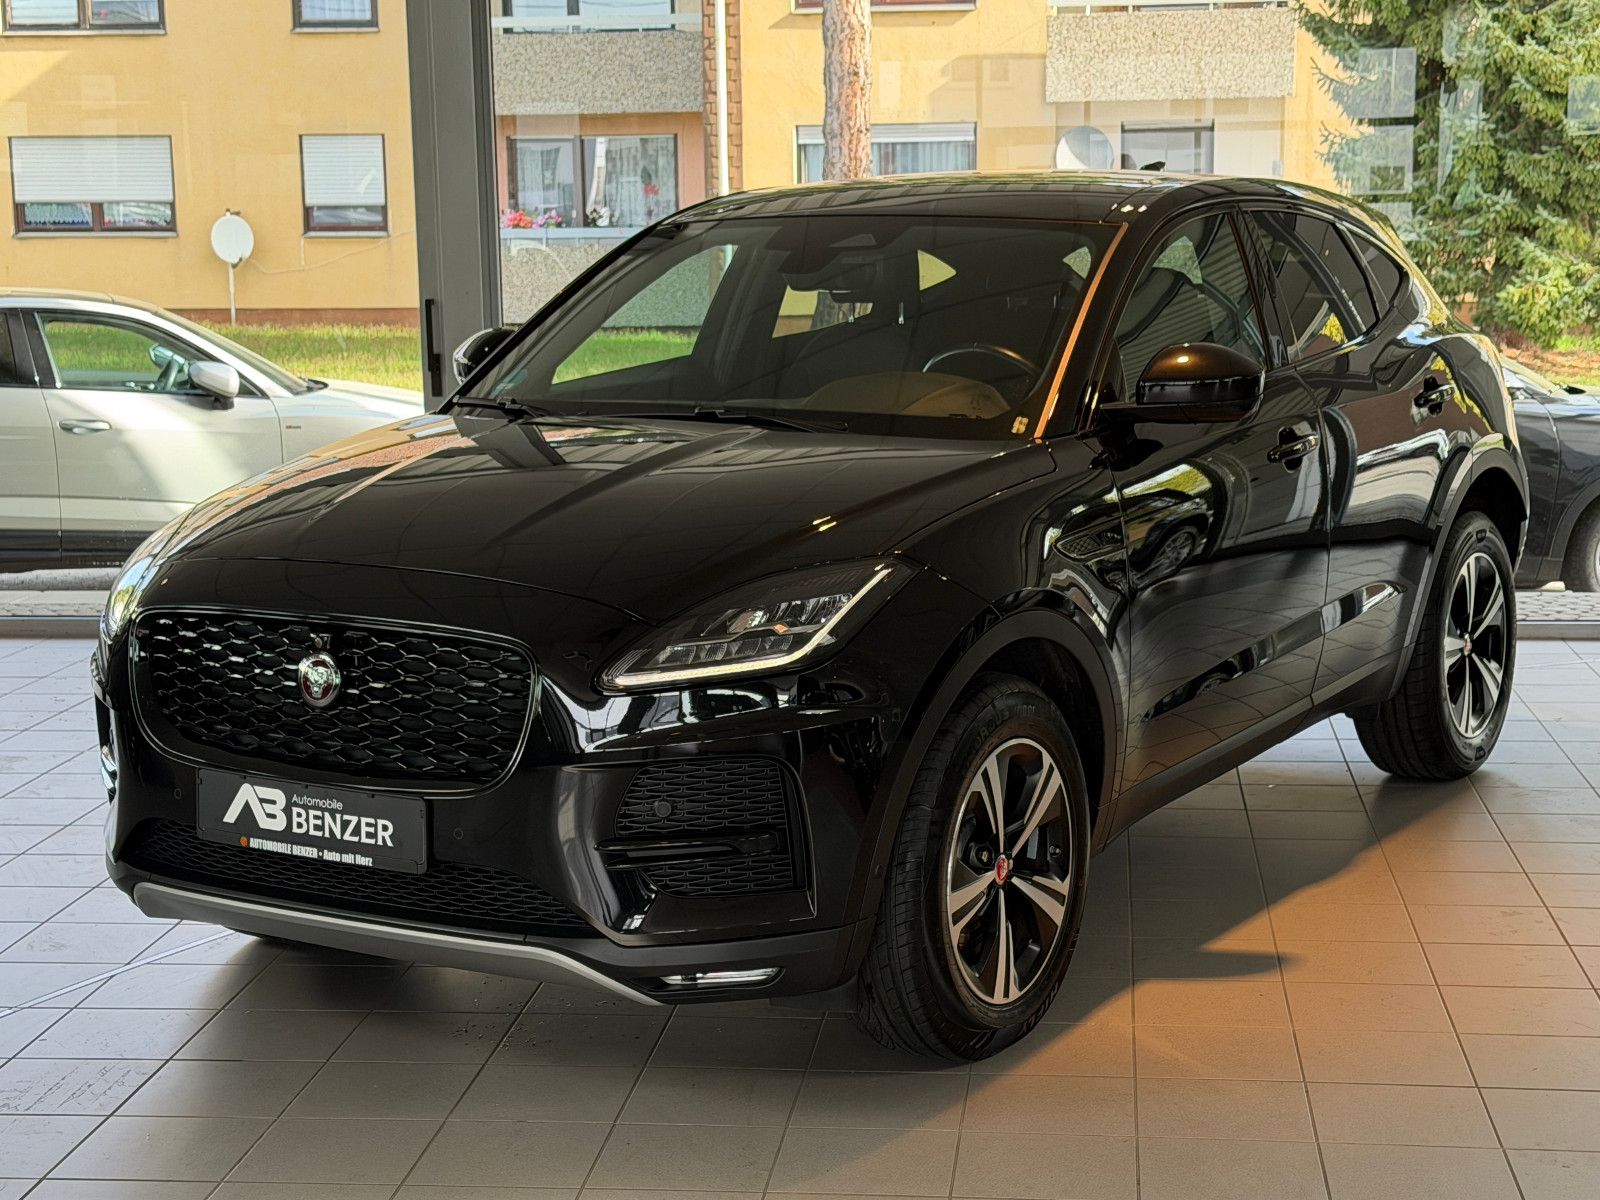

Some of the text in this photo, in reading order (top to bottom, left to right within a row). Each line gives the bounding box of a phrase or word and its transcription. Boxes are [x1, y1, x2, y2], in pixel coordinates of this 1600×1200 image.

[292, 794, 344, 810] Automobile
[291, 807, 394, 847] BENZER
[249, 837, 373, 867] AUTOMOBILE BENZER Auto mit Herz
